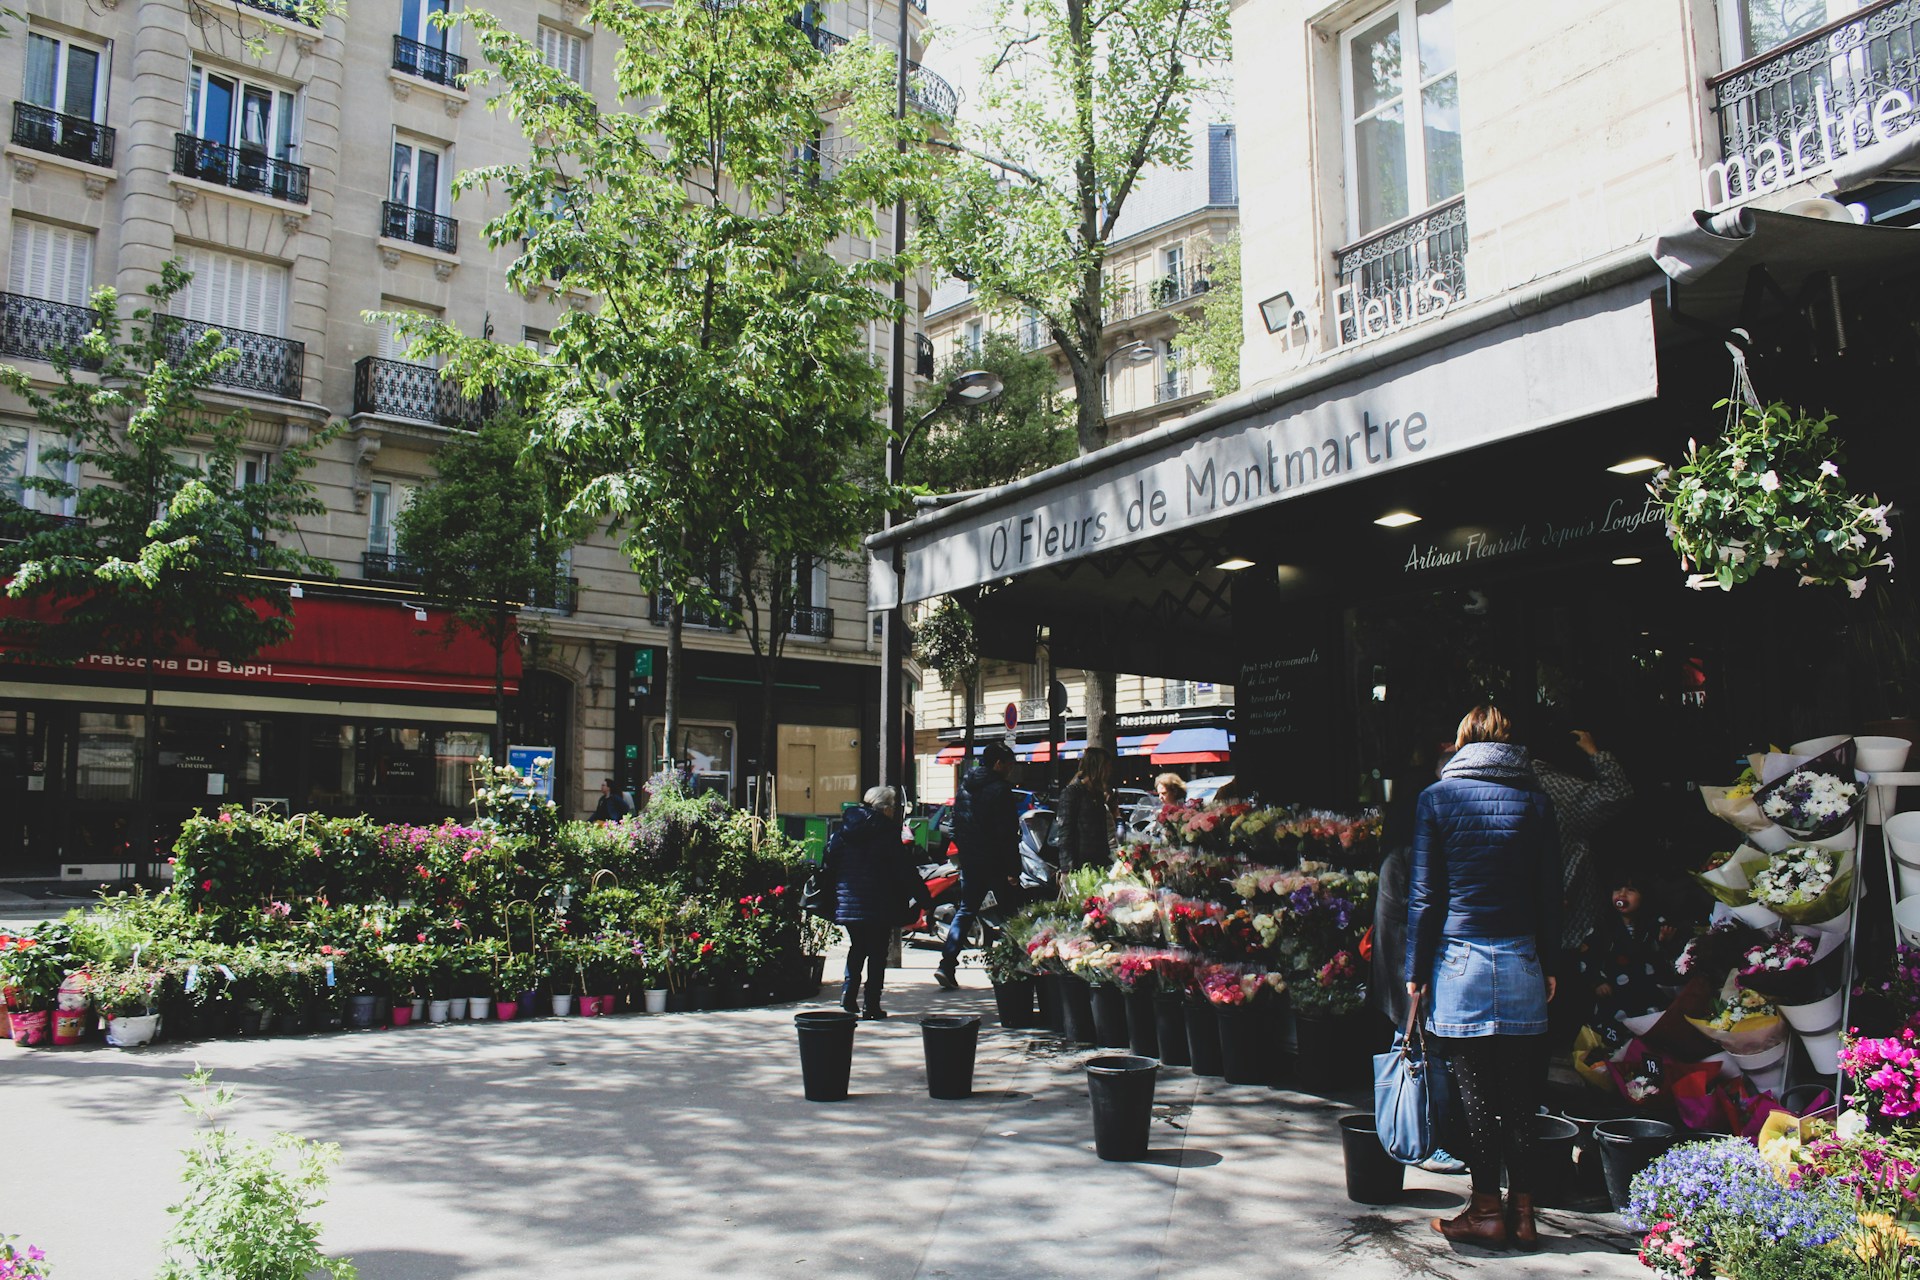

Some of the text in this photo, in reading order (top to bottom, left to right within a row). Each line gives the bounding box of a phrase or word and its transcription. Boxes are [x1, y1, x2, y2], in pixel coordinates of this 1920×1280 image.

[1126, 480, 1167, 533] de
[1185, 411, 1428, 517] Montmartre
[1403, 543, 1463, 573] Artisan
[1465, 523, 1532, 561] Fleuriste
[79, 652, 178, 670] rattoria
[186, 658, 208, 672] Di
[1120, 712, 1181, 727] Restaurant
